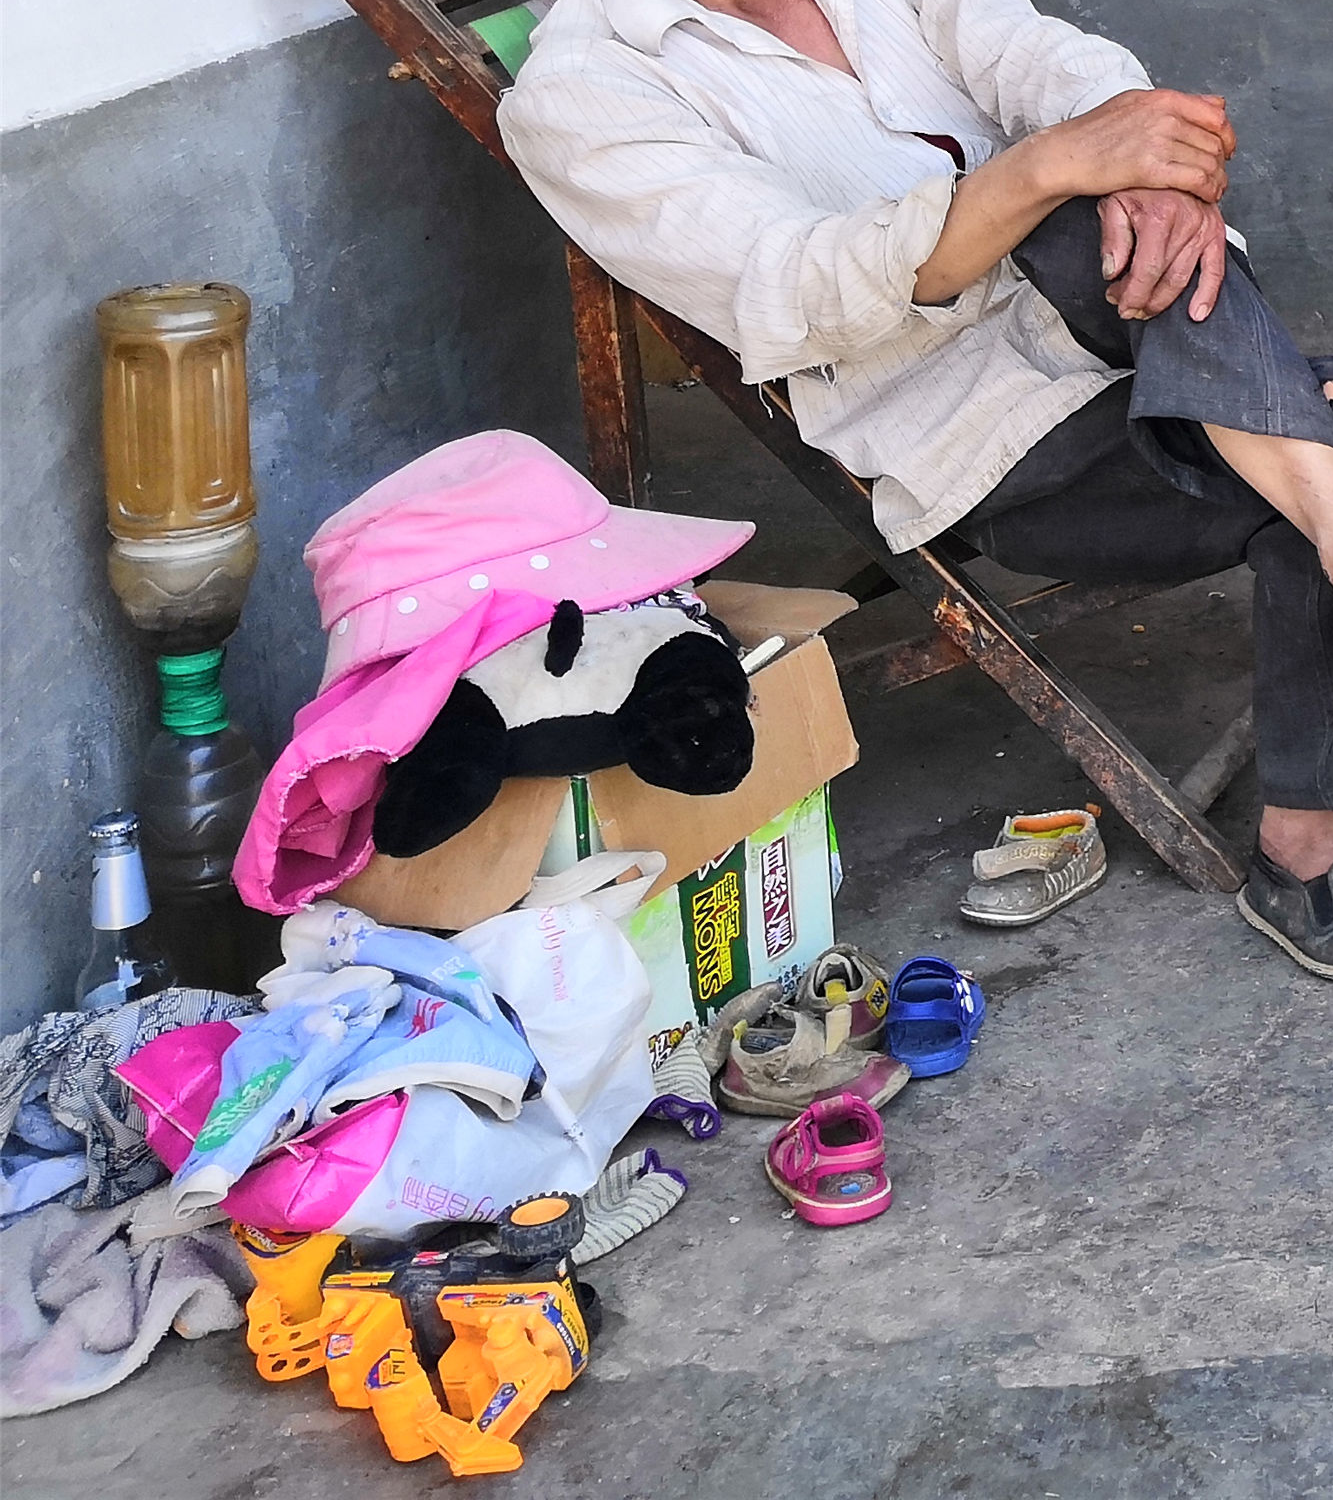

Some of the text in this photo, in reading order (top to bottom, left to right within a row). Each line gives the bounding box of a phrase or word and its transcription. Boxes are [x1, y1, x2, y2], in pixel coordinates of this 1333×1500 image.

[692, 886, 723, 1000] MONS
[762, 838, 793, 955] 自然之美
